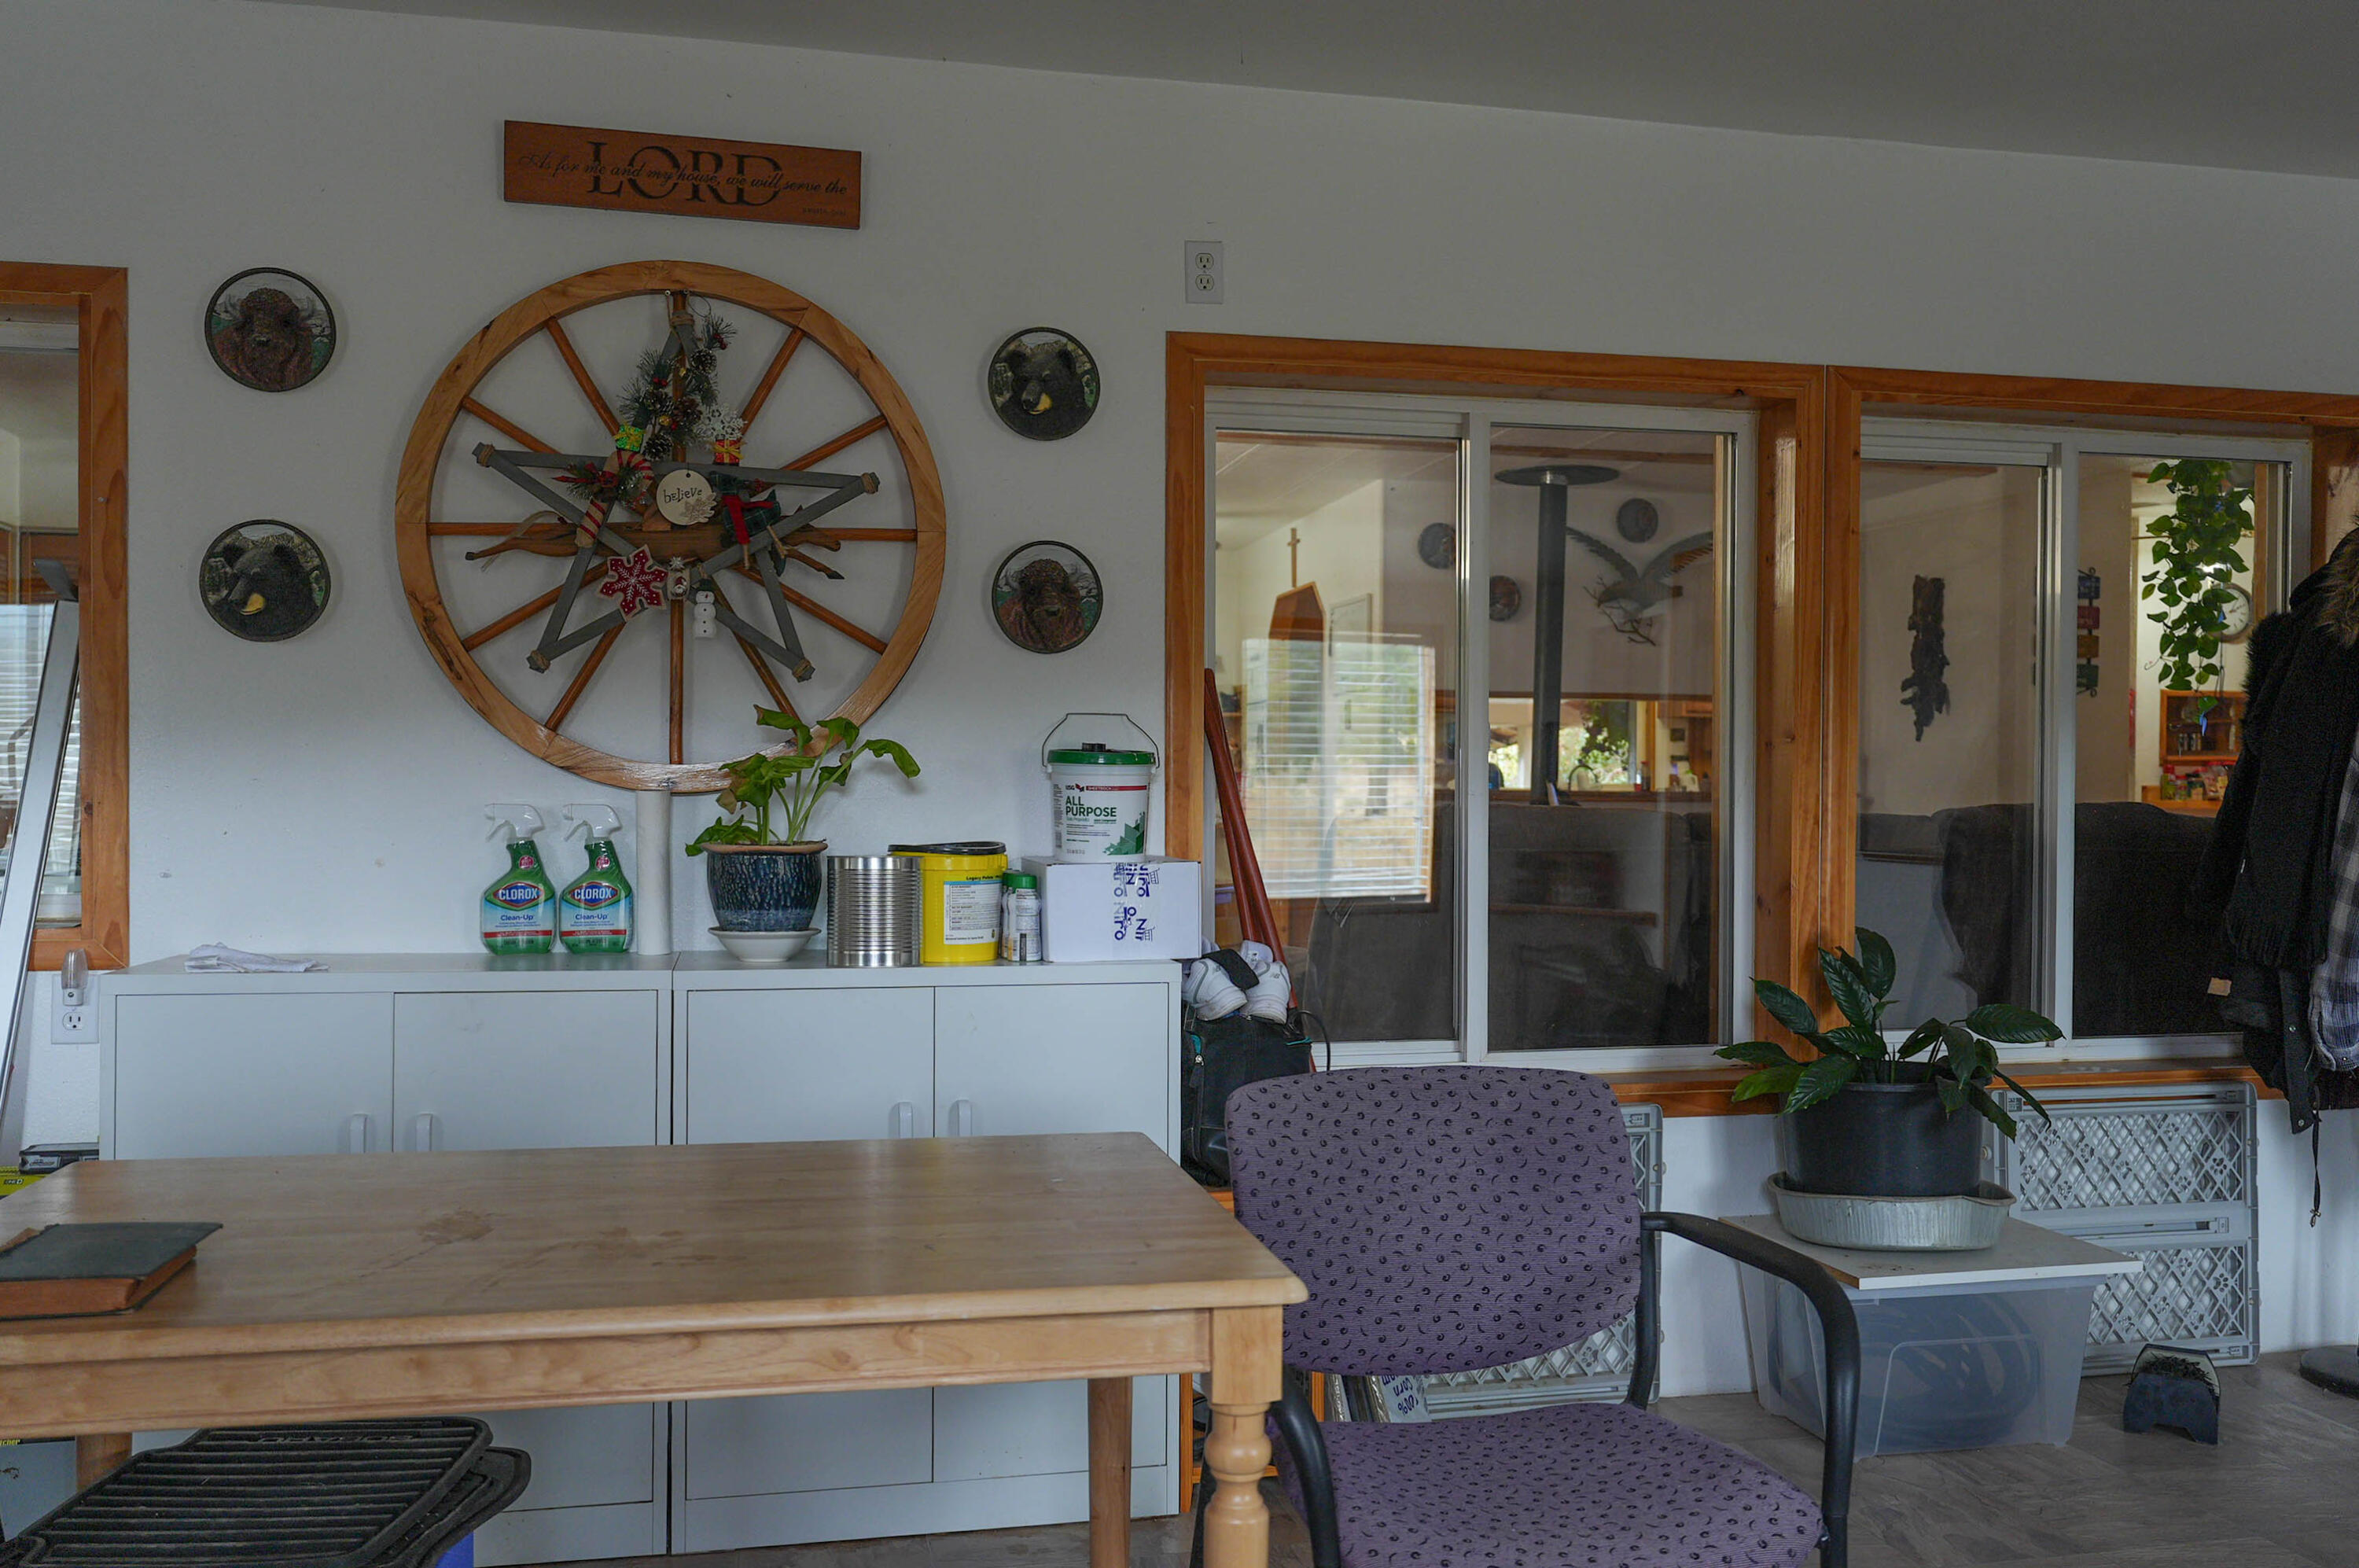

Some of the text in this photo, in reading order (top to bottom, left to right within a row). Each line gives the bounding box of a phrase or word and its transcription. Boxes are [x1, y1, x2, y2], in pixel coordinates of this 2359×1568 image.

[552, 155, 580, 178] for
[610, 162, 646, 178] and
[647, 168, 674, 187] my
[727, 175, 746, 186] we
[750, 174, 783, 190] will
[783, 181, 821, 192] serve
[824, 178, 848, 194] the
[587, 141, 784, 207] LORD
[1065, 796, 1084, 806] ALL
[1065, 806, 1117, 817] PURPOSE
[499, 888, 537, 900] CLOROX
[574, 887, 612, 900] CLOROX
